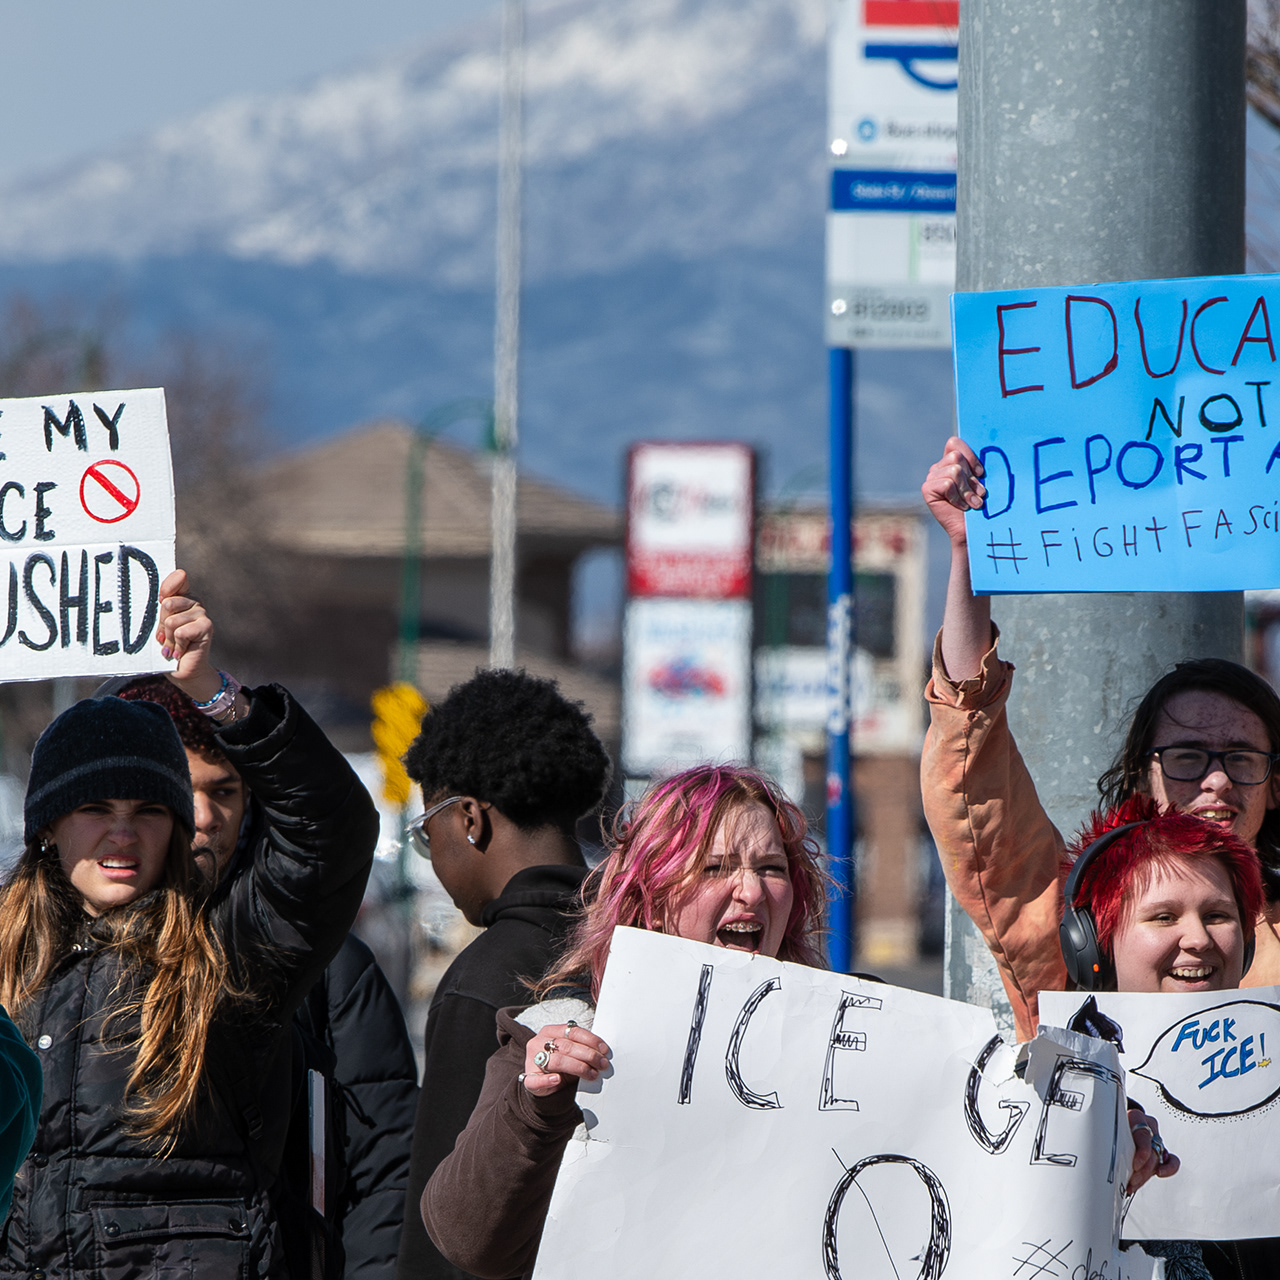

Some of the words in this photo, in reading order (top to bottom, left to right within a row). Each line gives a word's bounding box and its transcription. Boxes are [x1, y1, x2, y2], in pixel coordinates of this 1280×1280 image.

[41, 399, 126, 453] MY
[1146, 381, 1271, 441] NOT
[678, 963, 883, 1112] ICE
[1170, 1017, 1237, 1053] FUCK
[1198, 1032, 1272, 1090] ICE!
